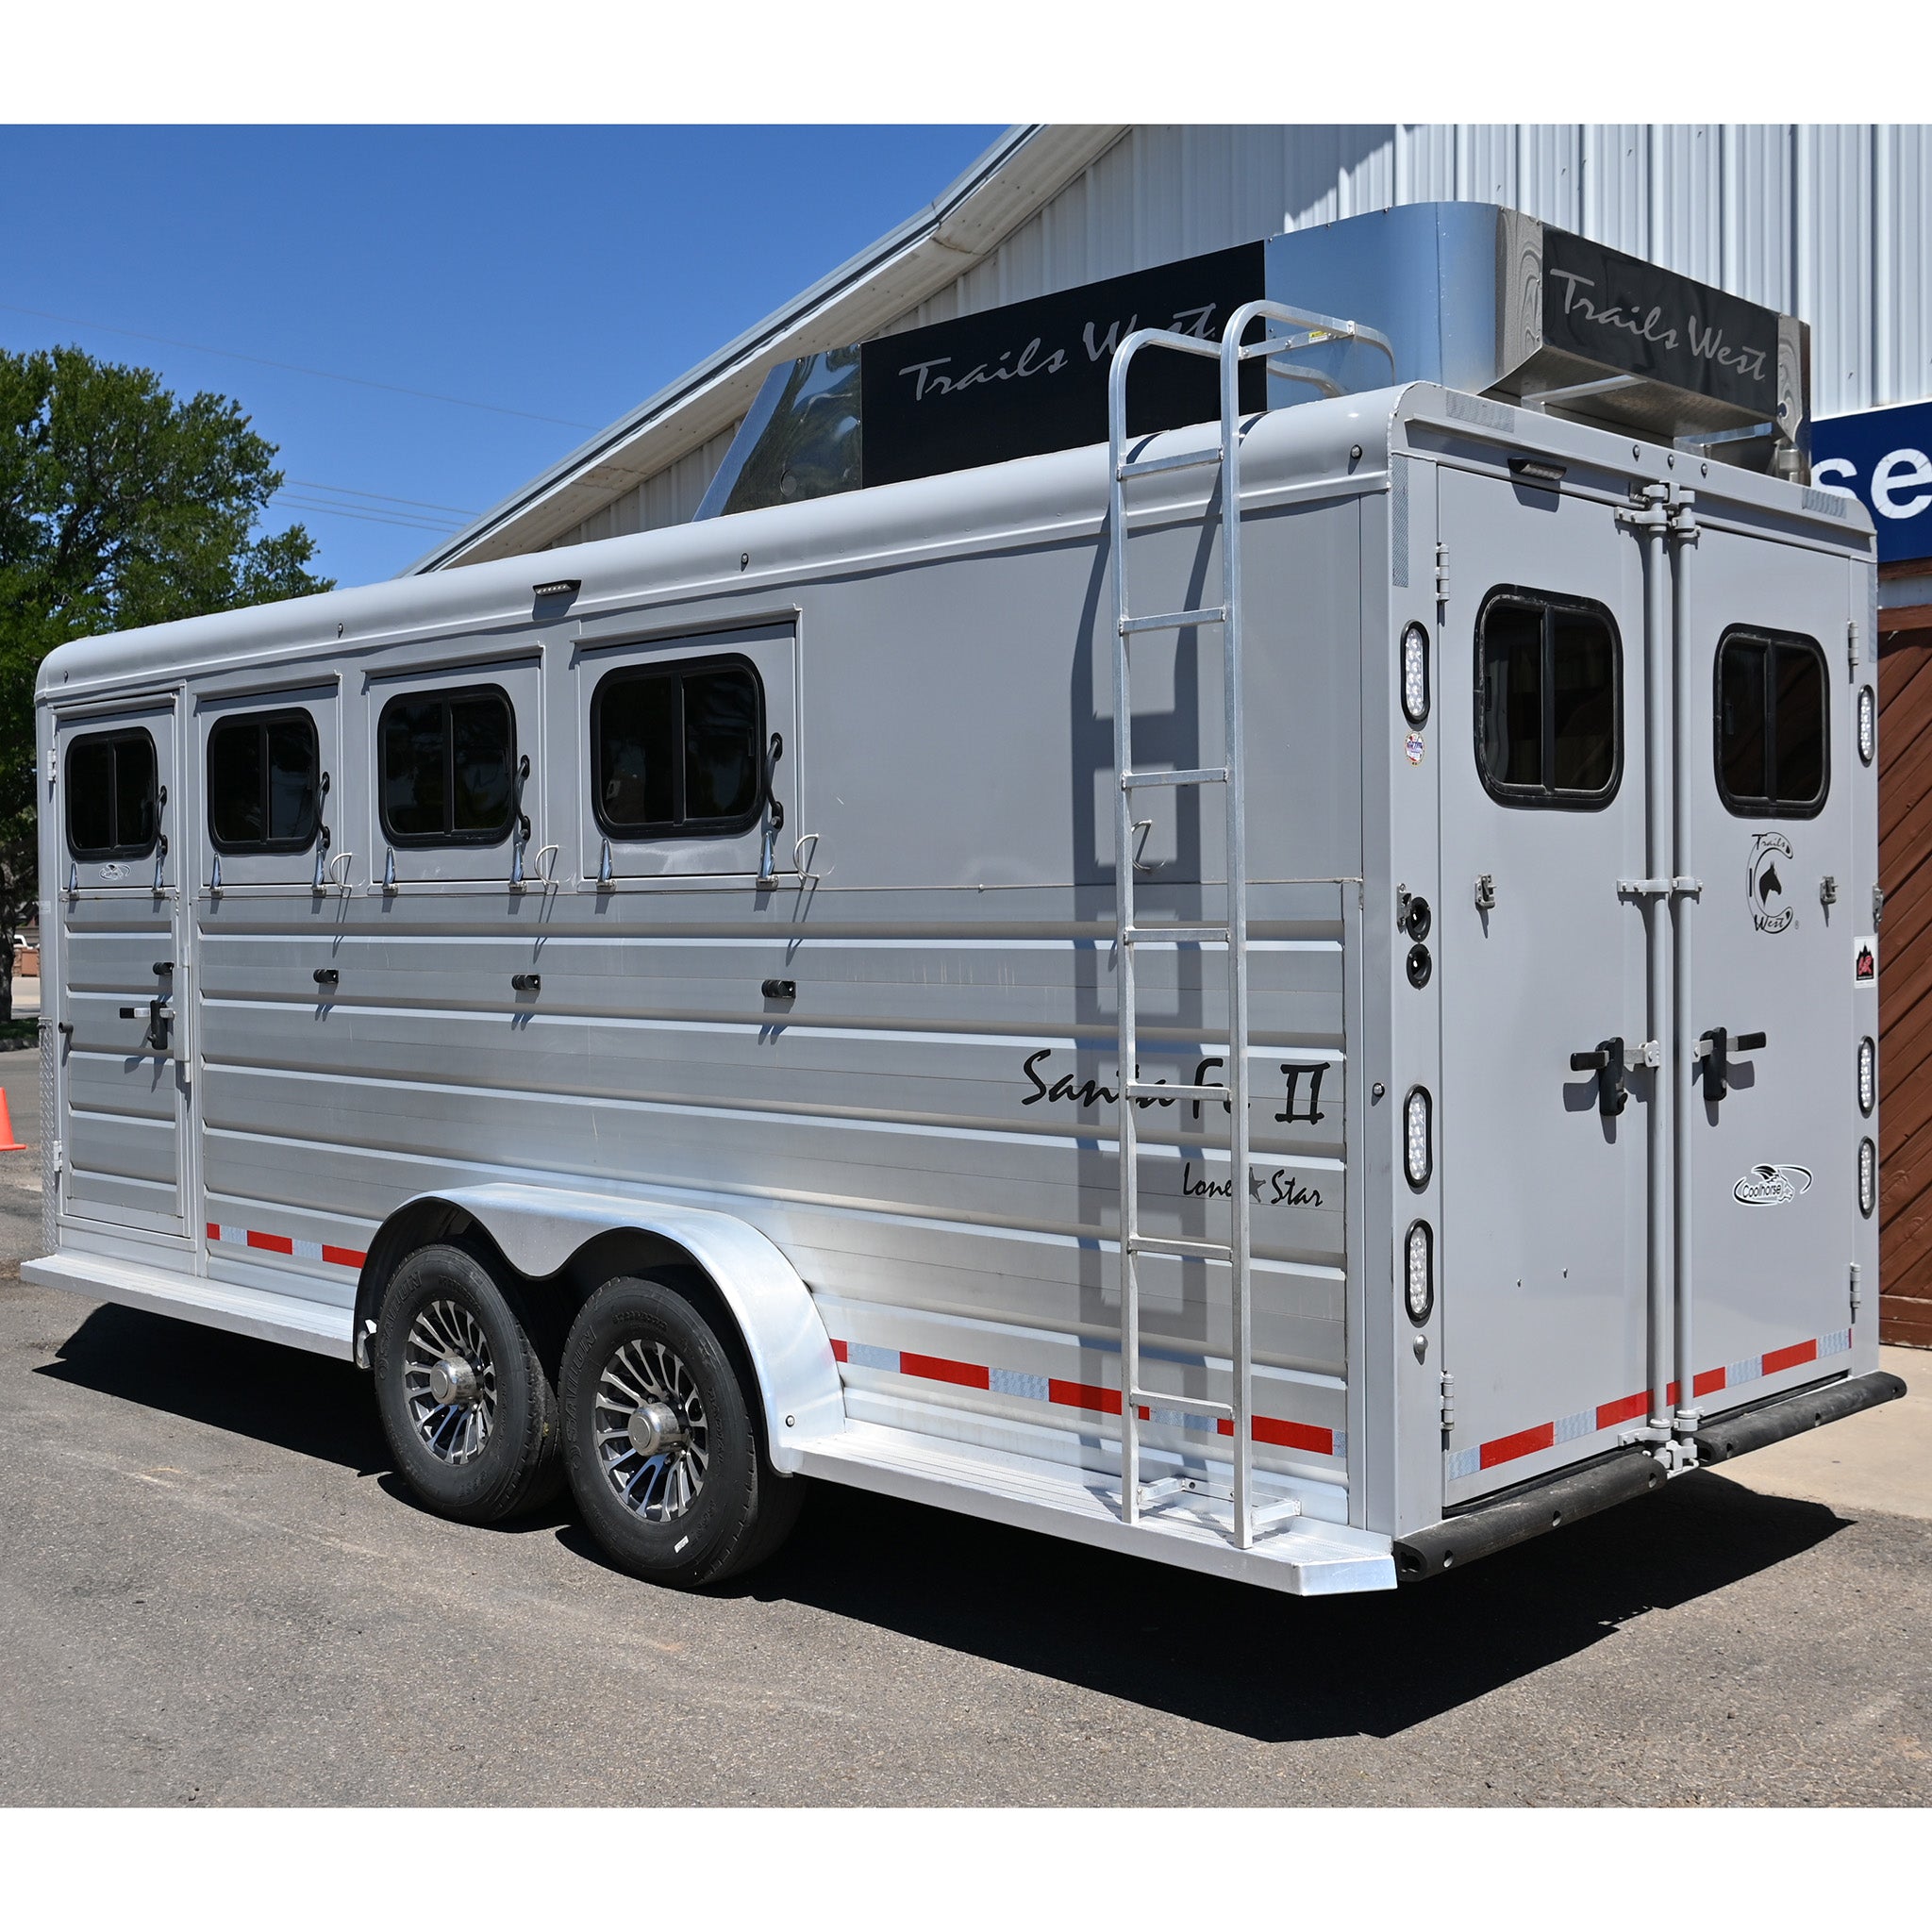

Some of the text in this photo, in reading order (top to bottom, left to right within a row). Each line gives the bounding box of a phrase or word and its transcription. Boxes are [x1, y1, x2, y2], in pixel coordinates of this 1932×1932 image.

[899, 302, 1215, 401] Trails Wt
[1550, 268, 1766, 380] Trails West
[1751, 833, 1786, 850] Trails
[1755, 914, 1784, 931] West
[1022, 1048, 1176, 1108] Sana
[1192, 1058, 1252, 1120] F
[1183, 1161, 1324, 1207] Lone Star
